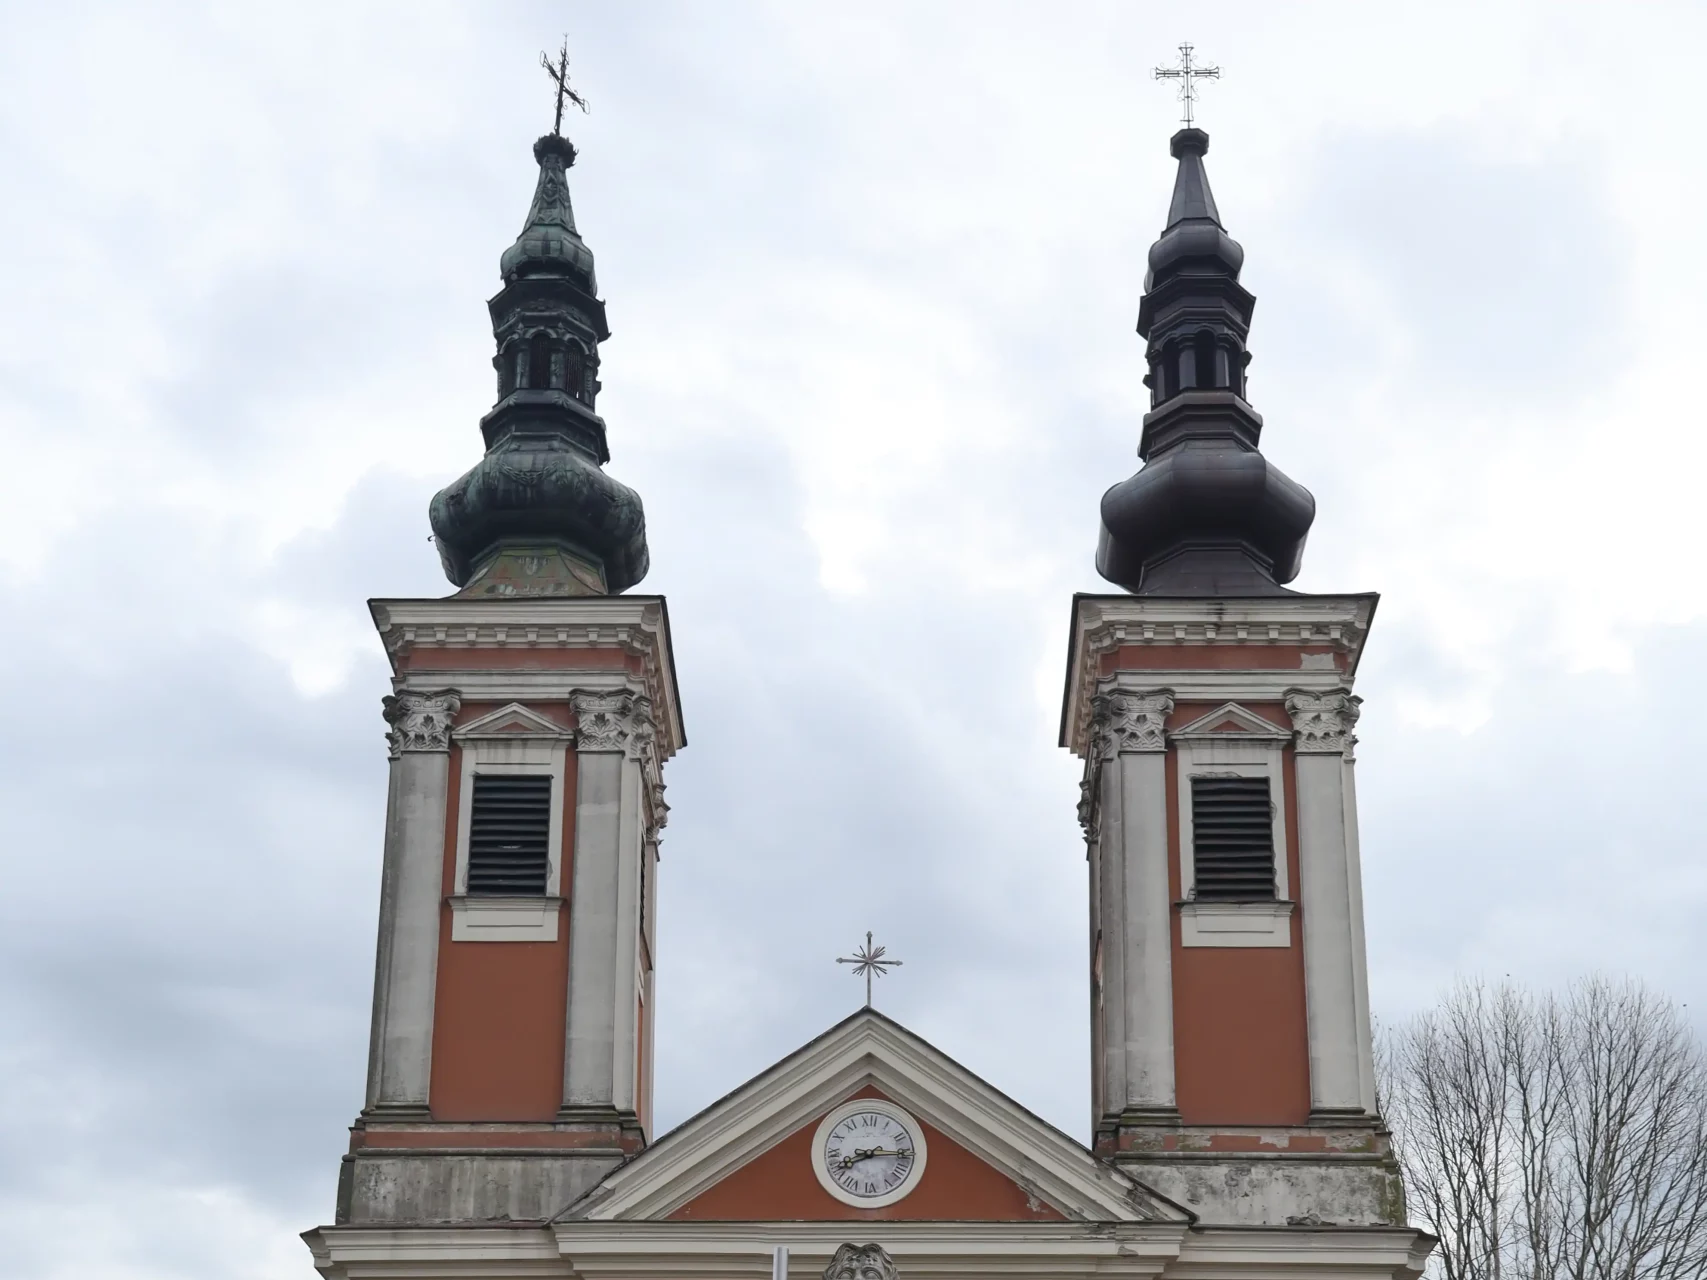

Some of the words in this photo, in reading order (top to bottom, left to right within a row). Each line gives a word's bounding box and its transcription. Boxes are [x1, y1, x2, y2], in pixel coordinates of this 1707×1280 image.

[843, 1119, 857, 1133] XI
[861, 1115, 878, 1127] XII
[882, 1120, 890, 1131] I
[832, 1132, 845, 1143] X
[893, 1132, 906, 1142] II
[843, 1176, 859, 1192] VII
[865, 1182, 877, 1194] VI
[884, 1179, 893, 1190] V
